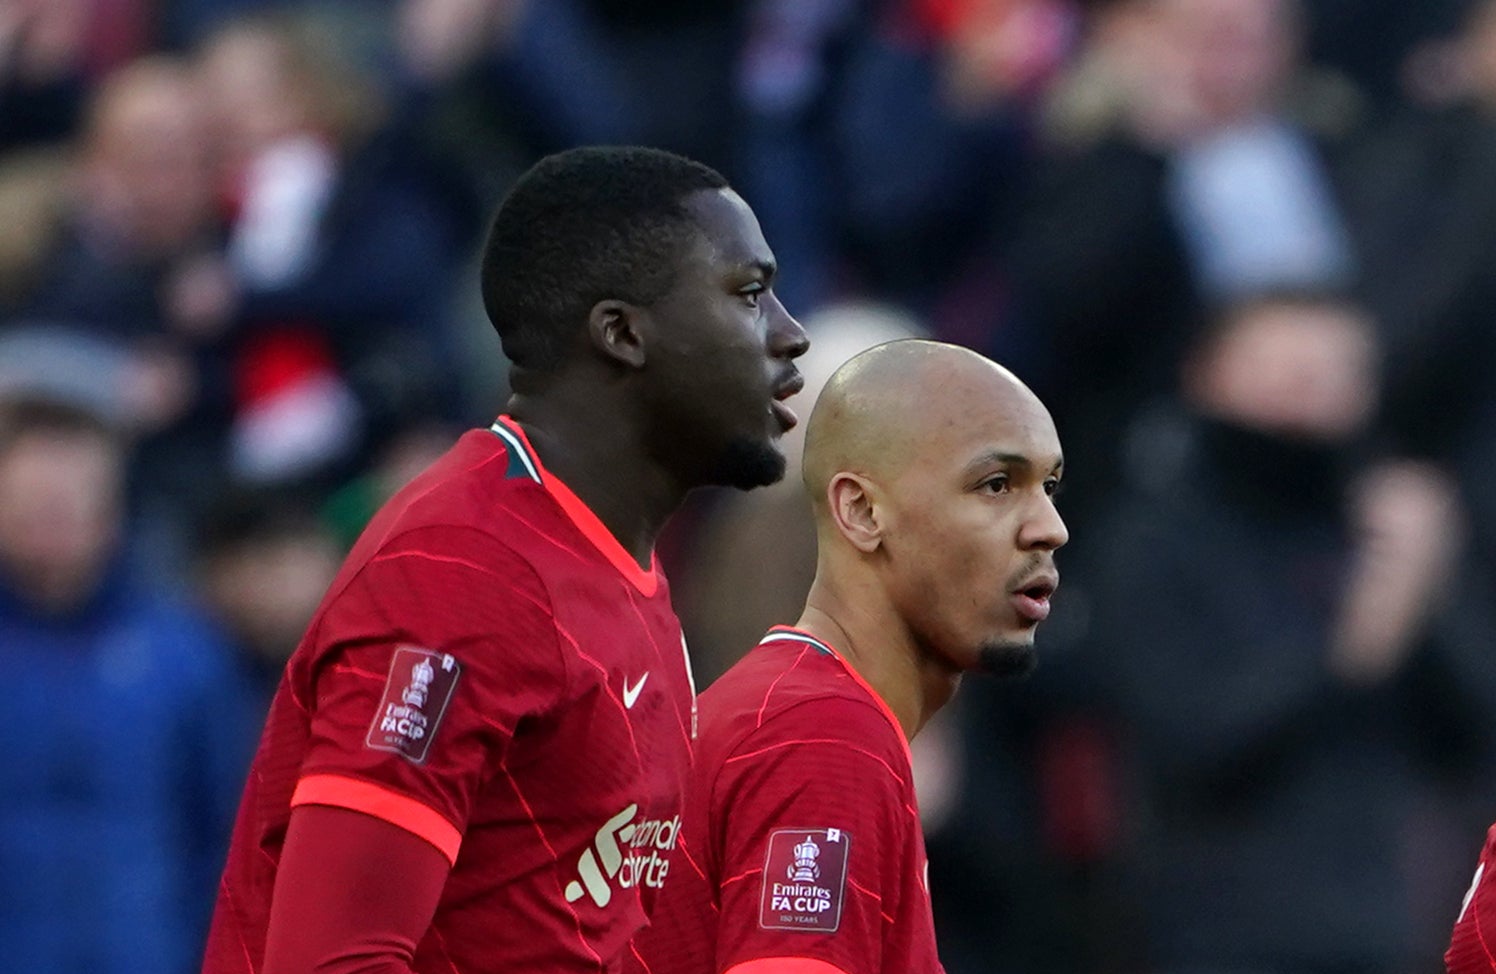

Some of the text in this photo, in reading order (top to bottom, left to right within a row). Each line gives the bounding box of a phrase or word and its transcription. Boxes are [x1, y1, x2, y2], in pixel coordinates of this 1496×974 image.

[381, 716, 397, 732] FA
[773, 883, 831, 899] Emirates
[771, 897, 831, 913] FA CUP
[794, 915, 818, 924] YEARS
